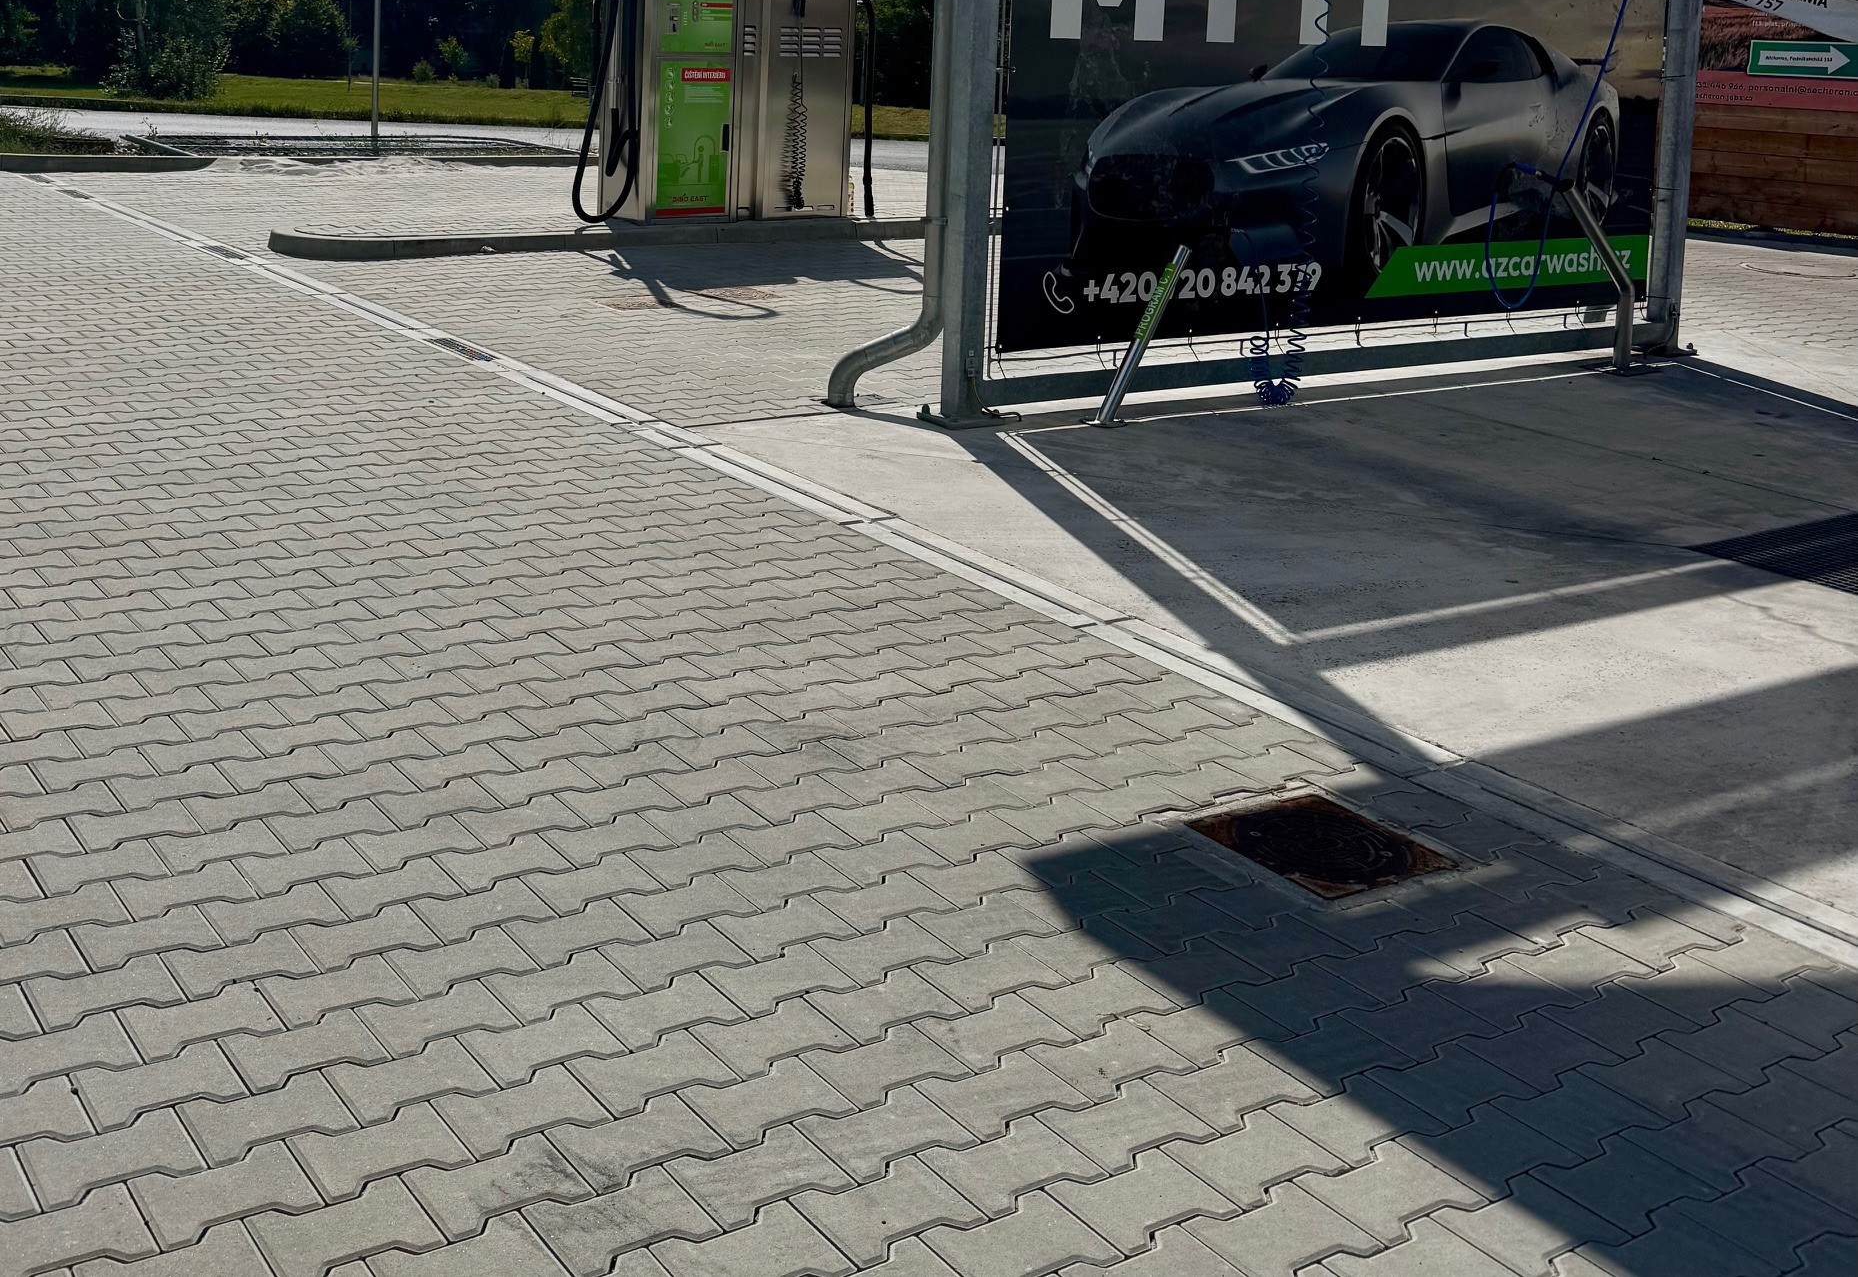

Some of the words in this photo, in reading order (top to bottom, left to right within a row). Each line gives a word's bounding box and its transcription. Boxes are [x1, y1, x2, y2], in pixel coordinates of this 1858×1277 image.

[1414, 241, 1631, 283] www.azcarwash.z
[1083, 271, 1158, 304] +420
[1169, 268, 1216, 300] 20
[1221, 265, 1271, 297] 842
[1135, 285, 1165, 336] PROGRAM
